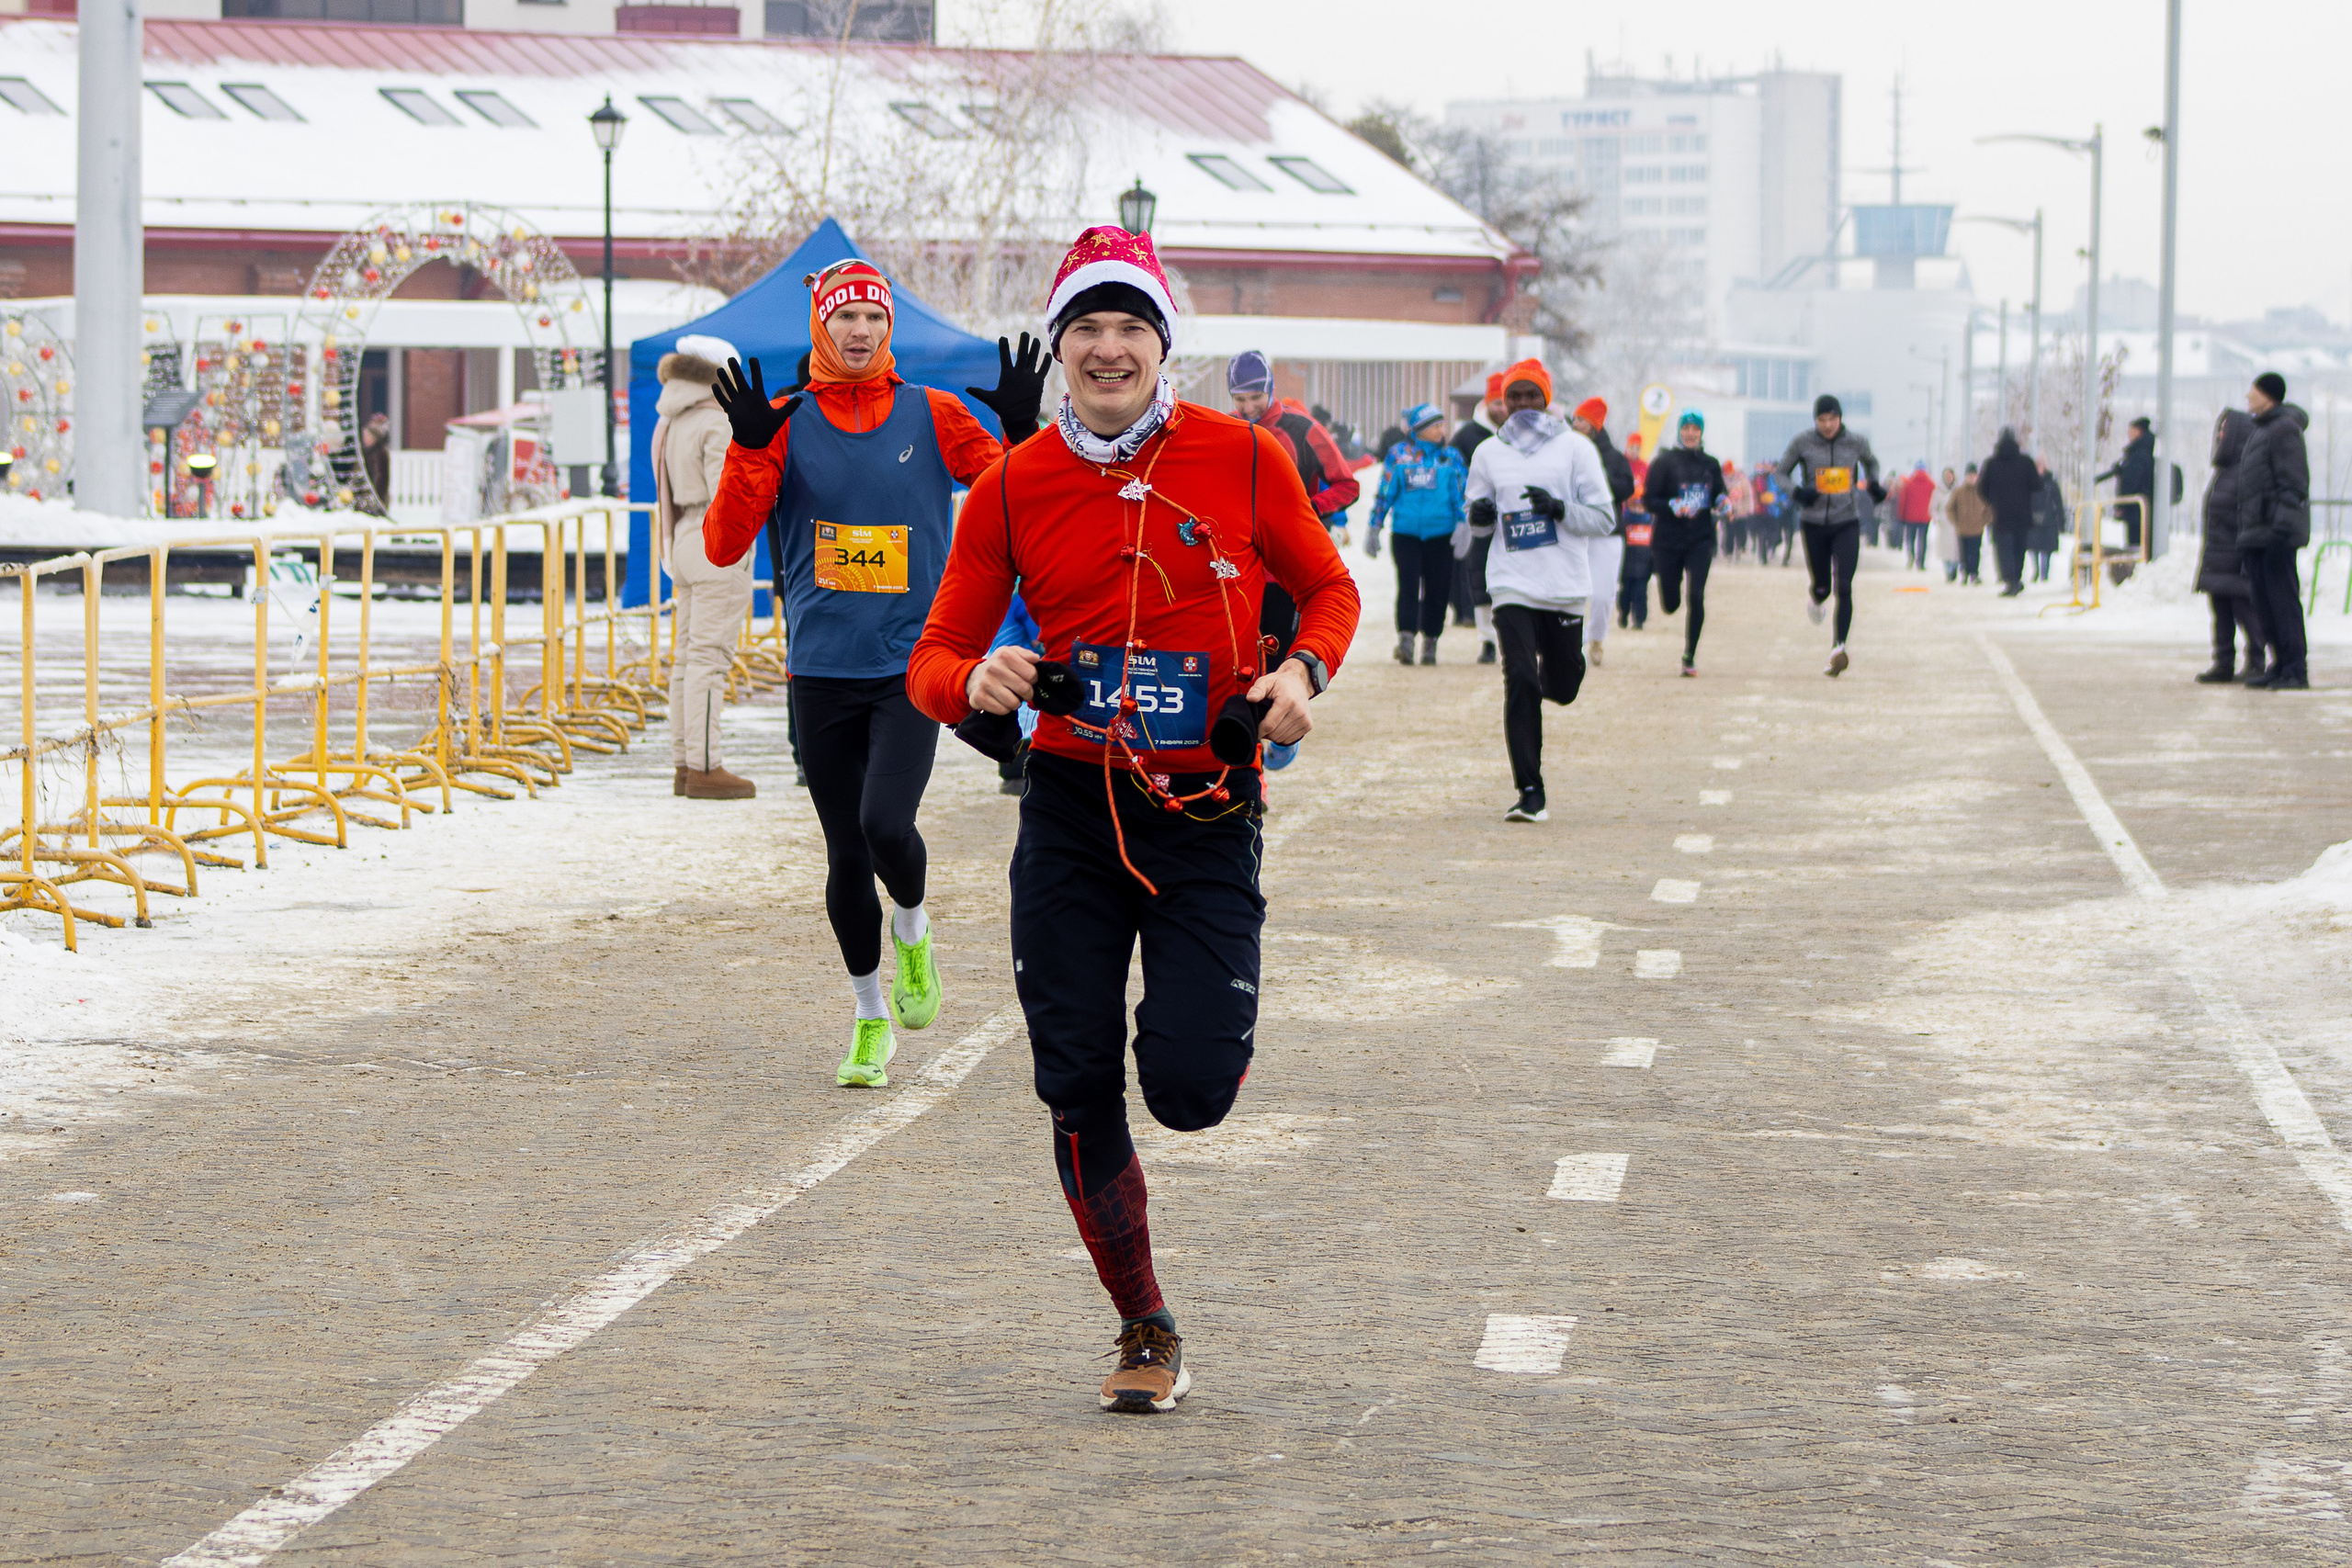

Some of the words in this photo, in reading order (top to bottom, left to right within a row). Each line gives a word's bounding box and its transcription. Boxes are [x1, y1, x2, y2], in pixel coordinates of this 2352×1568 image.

[819, 286, 862, 321] COOL
[1510, 522, 1546, 537] 1732
[834, 548, 886, 568] 344
